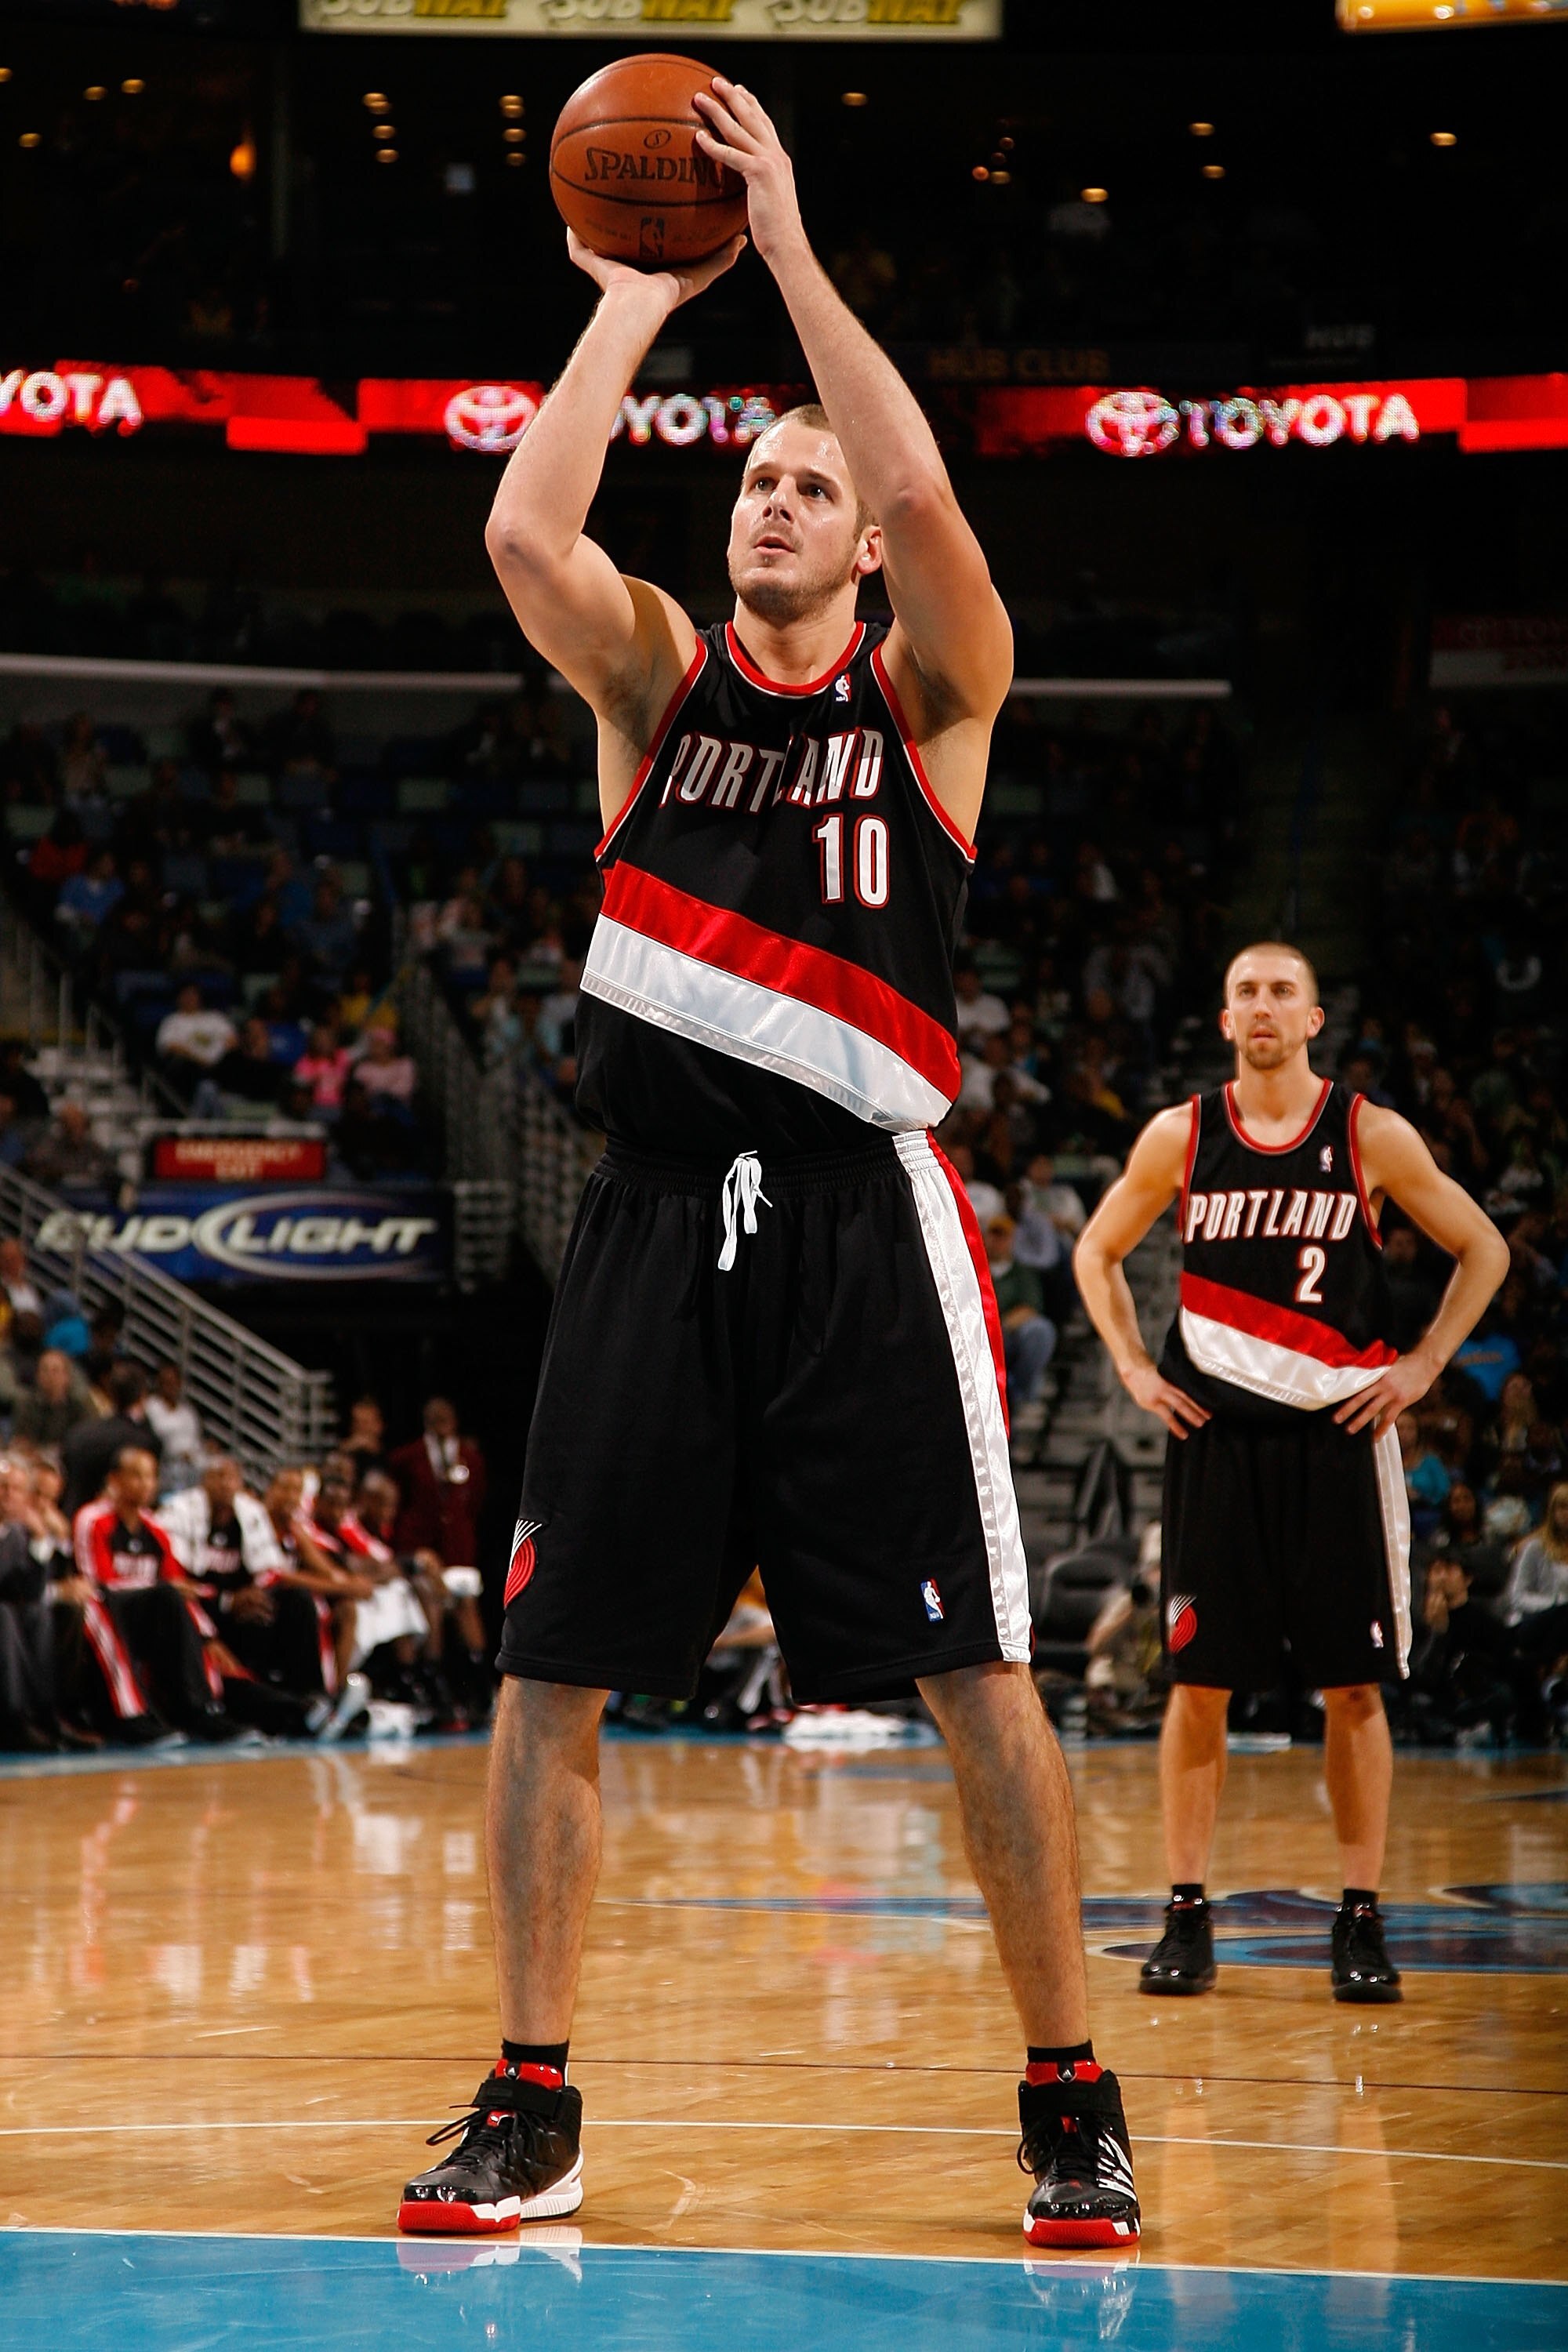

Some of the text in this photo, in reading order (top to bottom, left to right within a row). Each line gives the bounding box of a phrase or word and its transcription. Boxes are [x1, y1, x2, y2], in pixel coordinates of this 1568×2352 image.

[543, 394, 776, 445] YOTA
[1178, 394, 1420, 448] TOYOTA
[659, 728, 884, 814] PORTAND
[812, 812, 889, 909] 10
[227, 1214, 437, 1254] LIGHT
[1183, 1189, 1358, 1243] PORTLAND
[1294, 1243, 1326, 1305] 2
